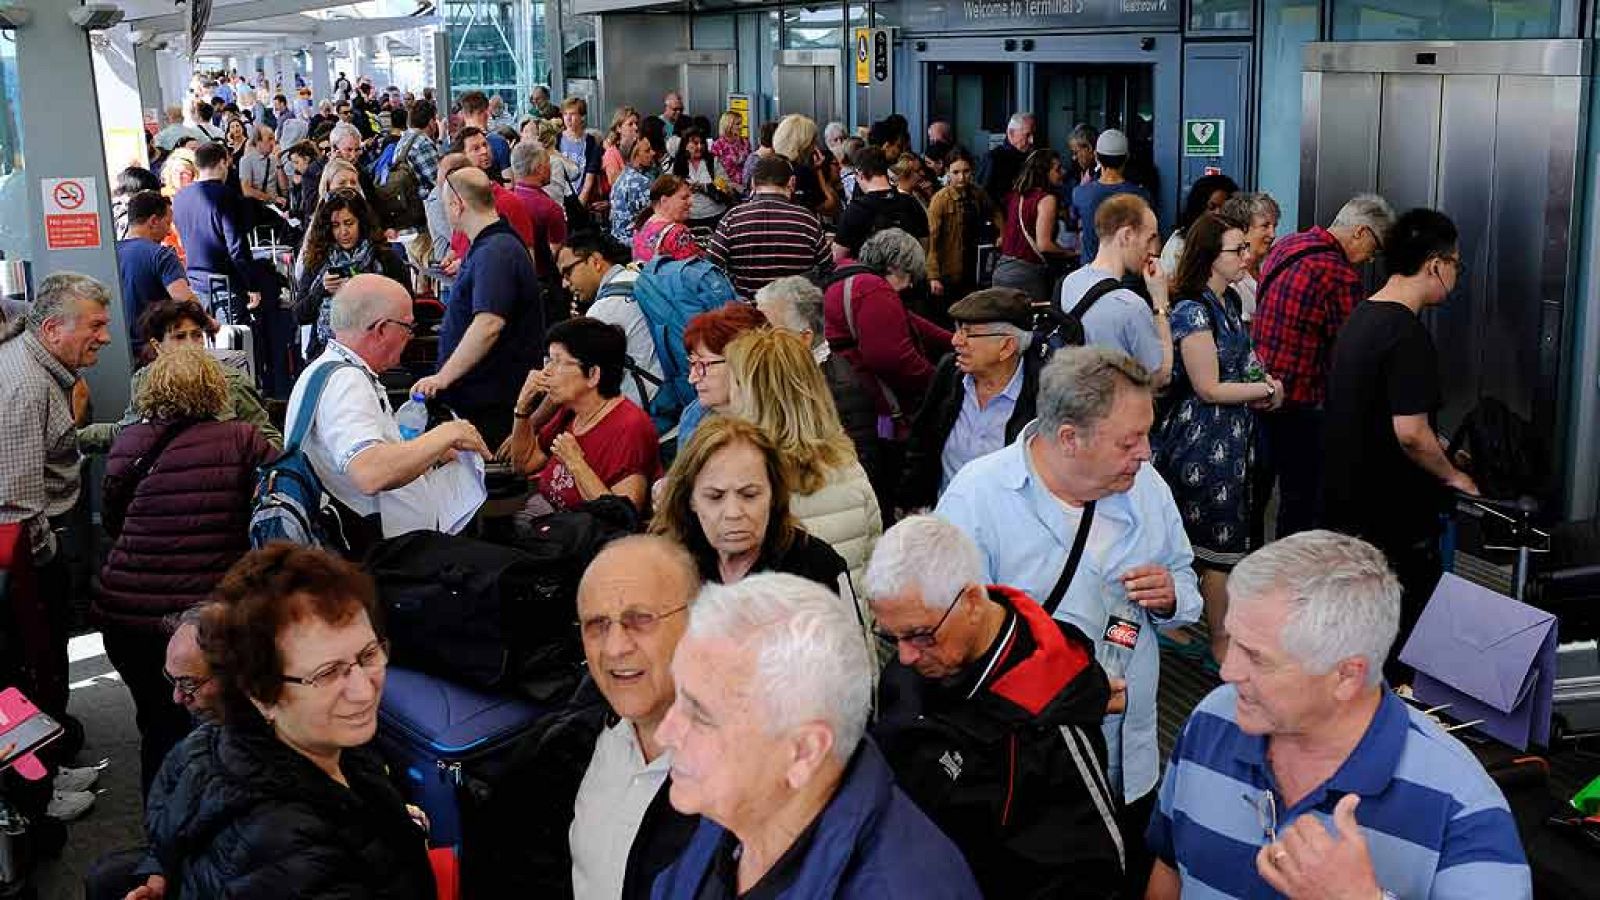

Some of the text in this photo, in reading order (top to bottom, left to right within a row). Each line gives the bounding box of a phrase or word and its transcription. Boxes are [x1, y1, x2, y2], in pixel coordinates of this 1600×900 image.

[963, 0, 1008, 19] Welcome
[1010, 0, 1021, 16] to
[1024, 0, 1073, 15] Terminal
[49, 218, 62, 226] No
